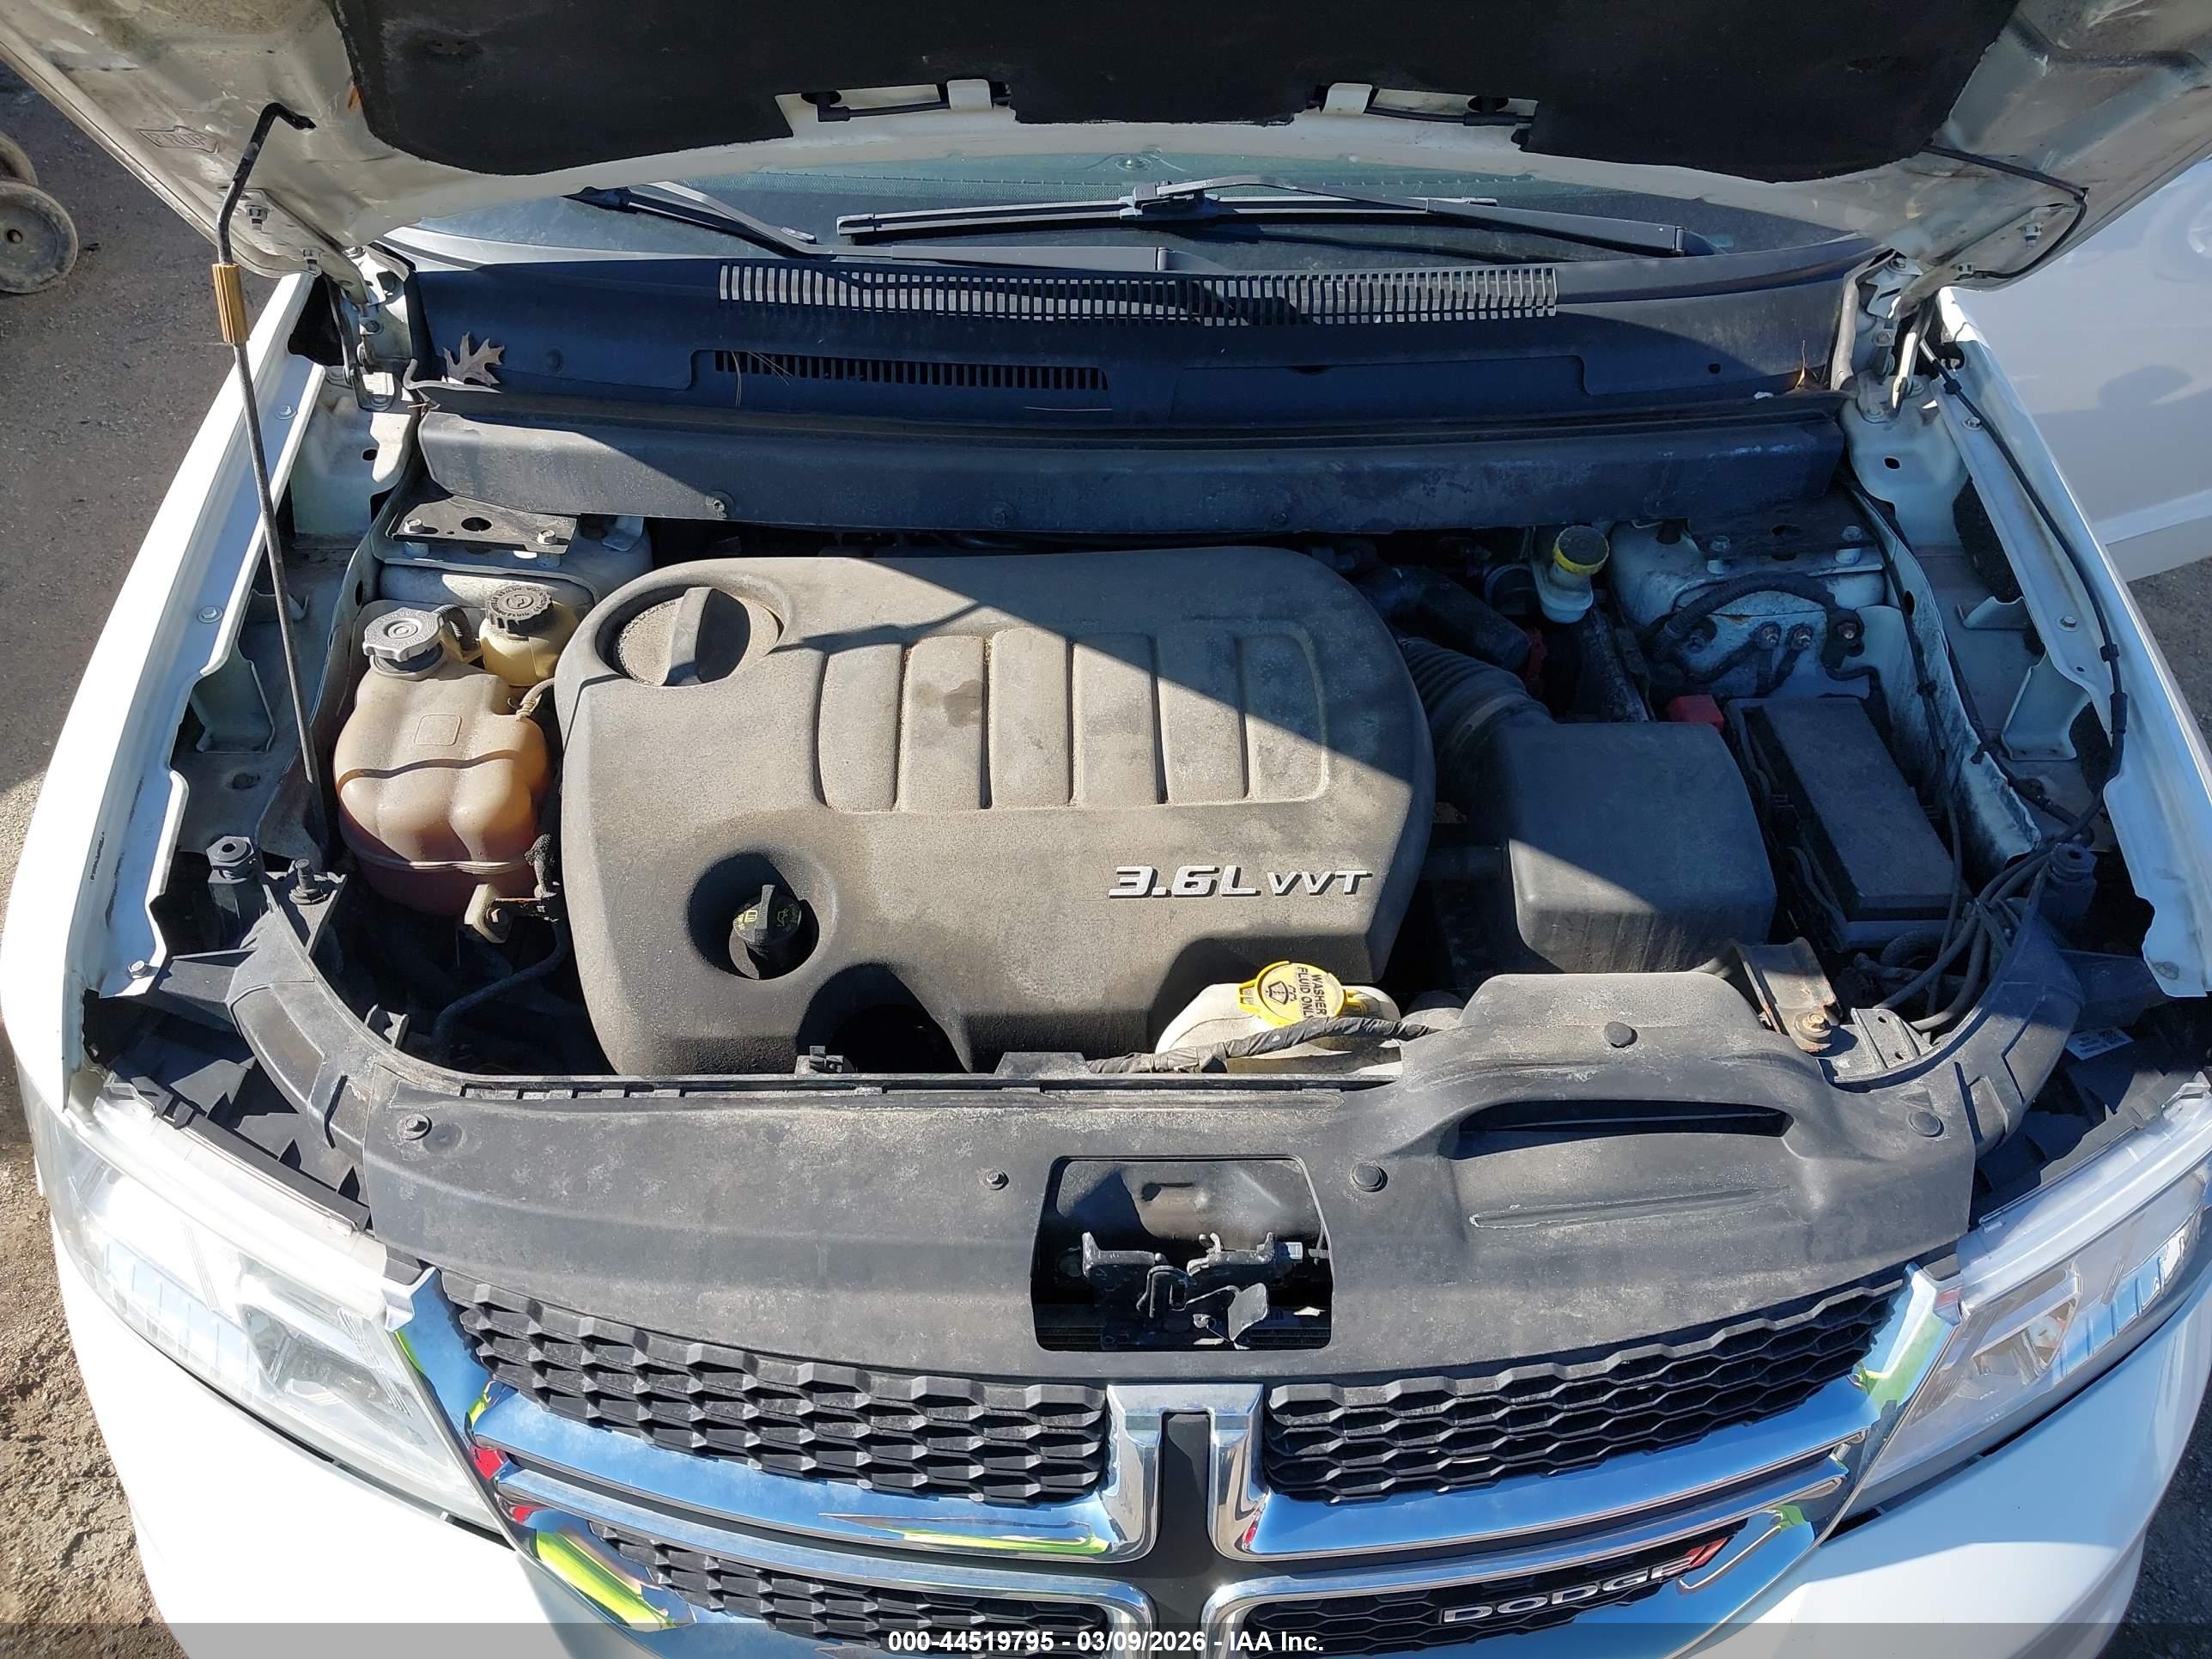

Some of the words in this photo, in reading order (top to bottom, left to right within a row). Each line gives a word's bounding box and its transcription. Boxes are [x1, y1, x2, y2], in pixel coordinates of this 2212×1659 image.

[1109, 865, 1260, 897] 3.6L
[1267, 870, 1371, 896] VVT
[1297, 966, 1310, 994] FLUID
[1310, 974, 1328, 1016] WASHER
[1443, 1554, 1696, 1623] DODGE
